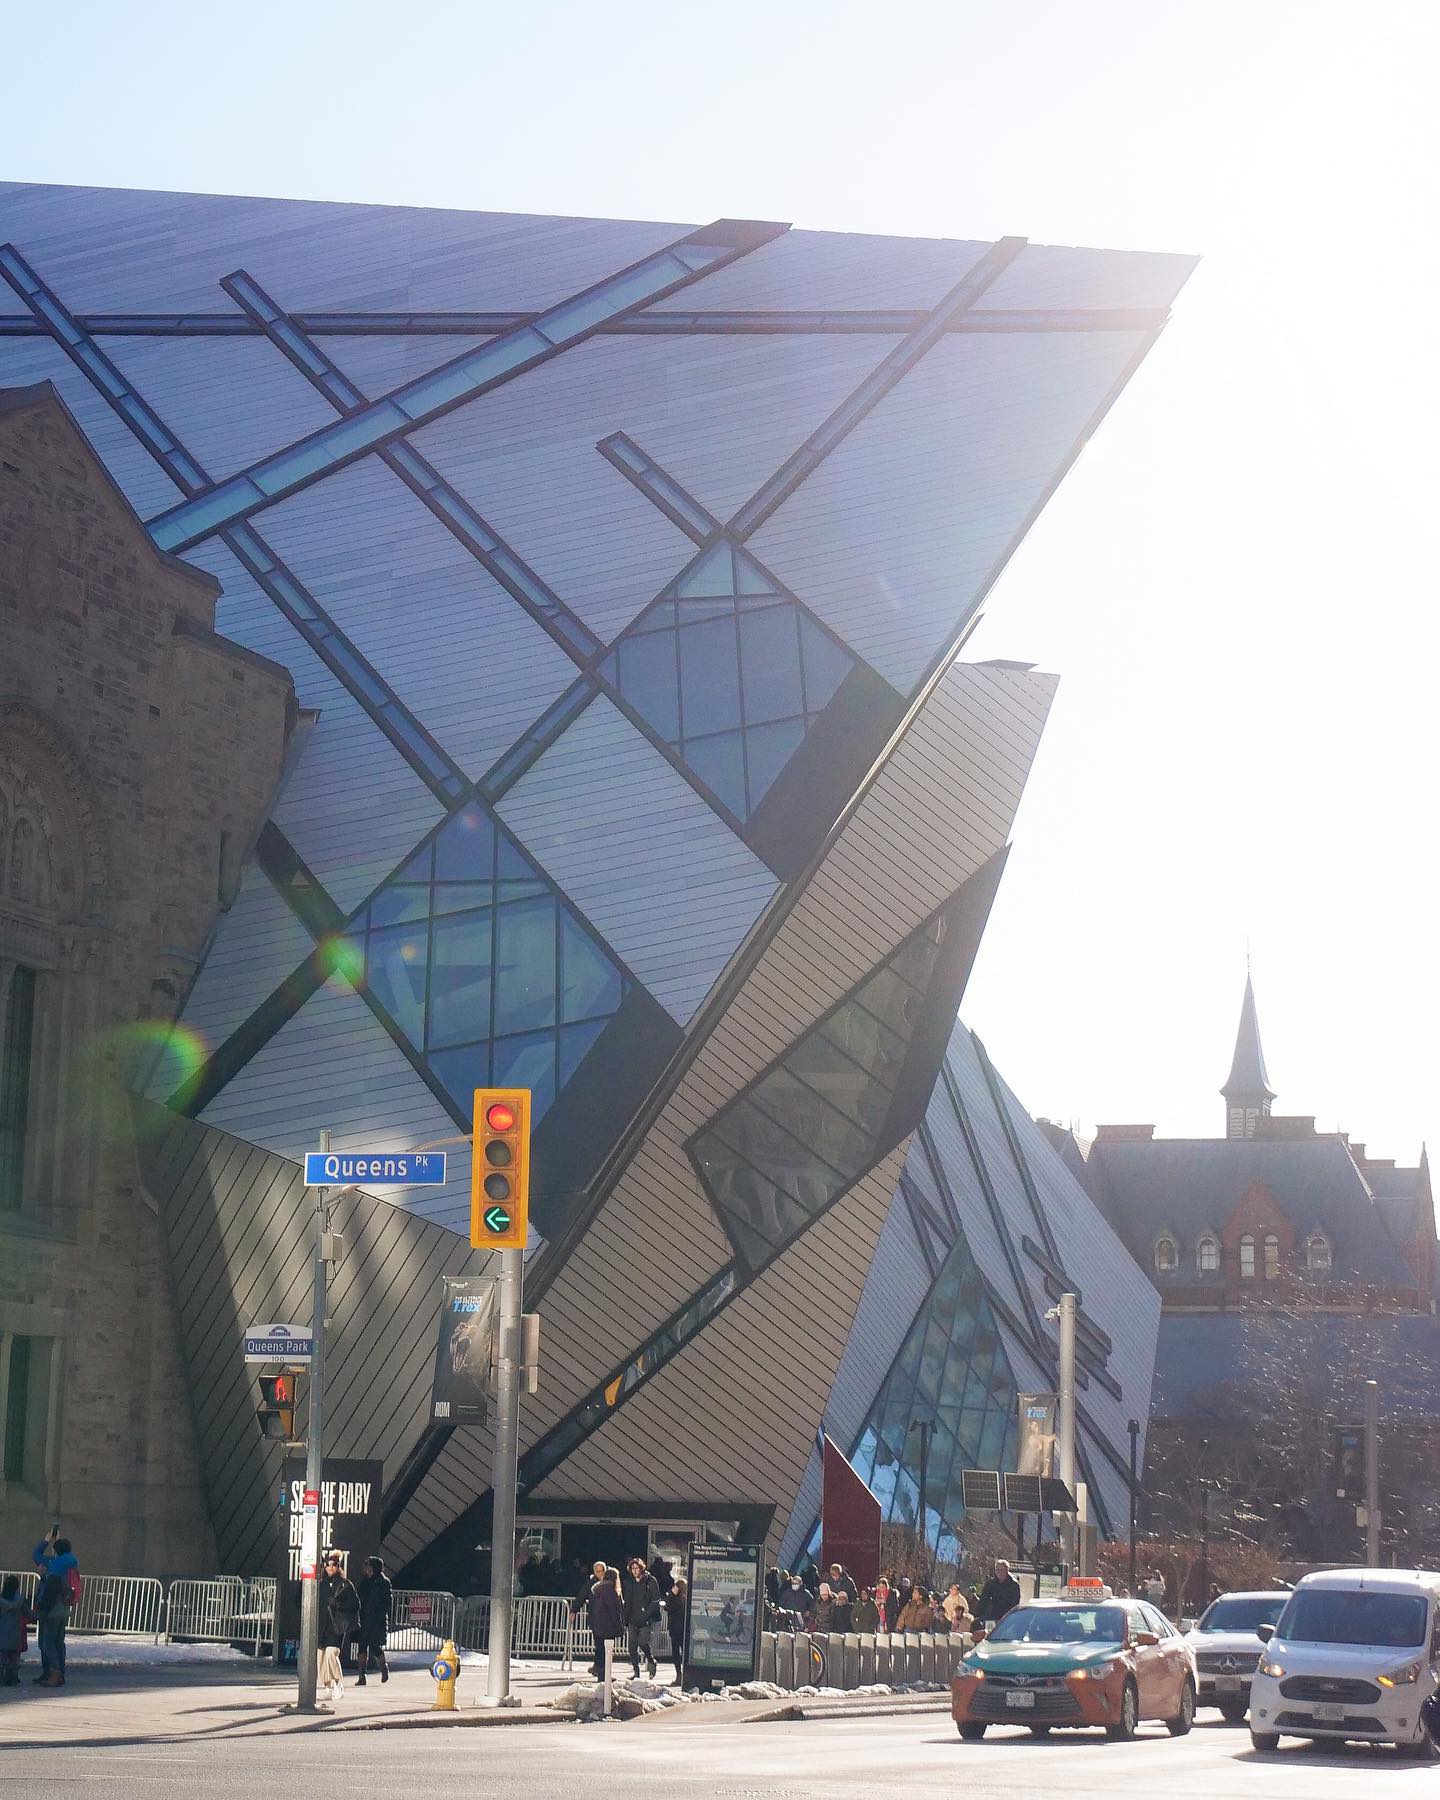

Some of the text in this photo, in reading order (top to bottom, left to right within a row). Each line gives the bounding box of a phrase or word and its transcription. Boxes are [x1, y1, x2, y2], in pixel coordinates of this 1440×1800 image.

[324, 1155, 429, 1179] Queens Pk
[247, 1340, 308, 1352] Queens Park
[290, 1480, 307, 1512] SE
[320, 1481, 336, 1514] HE
[338, 1482, 371, 1514] BABY
[289, 1514, 334, 1548] BERE
[1066, 1588, 1104, 1596] 751-5555
